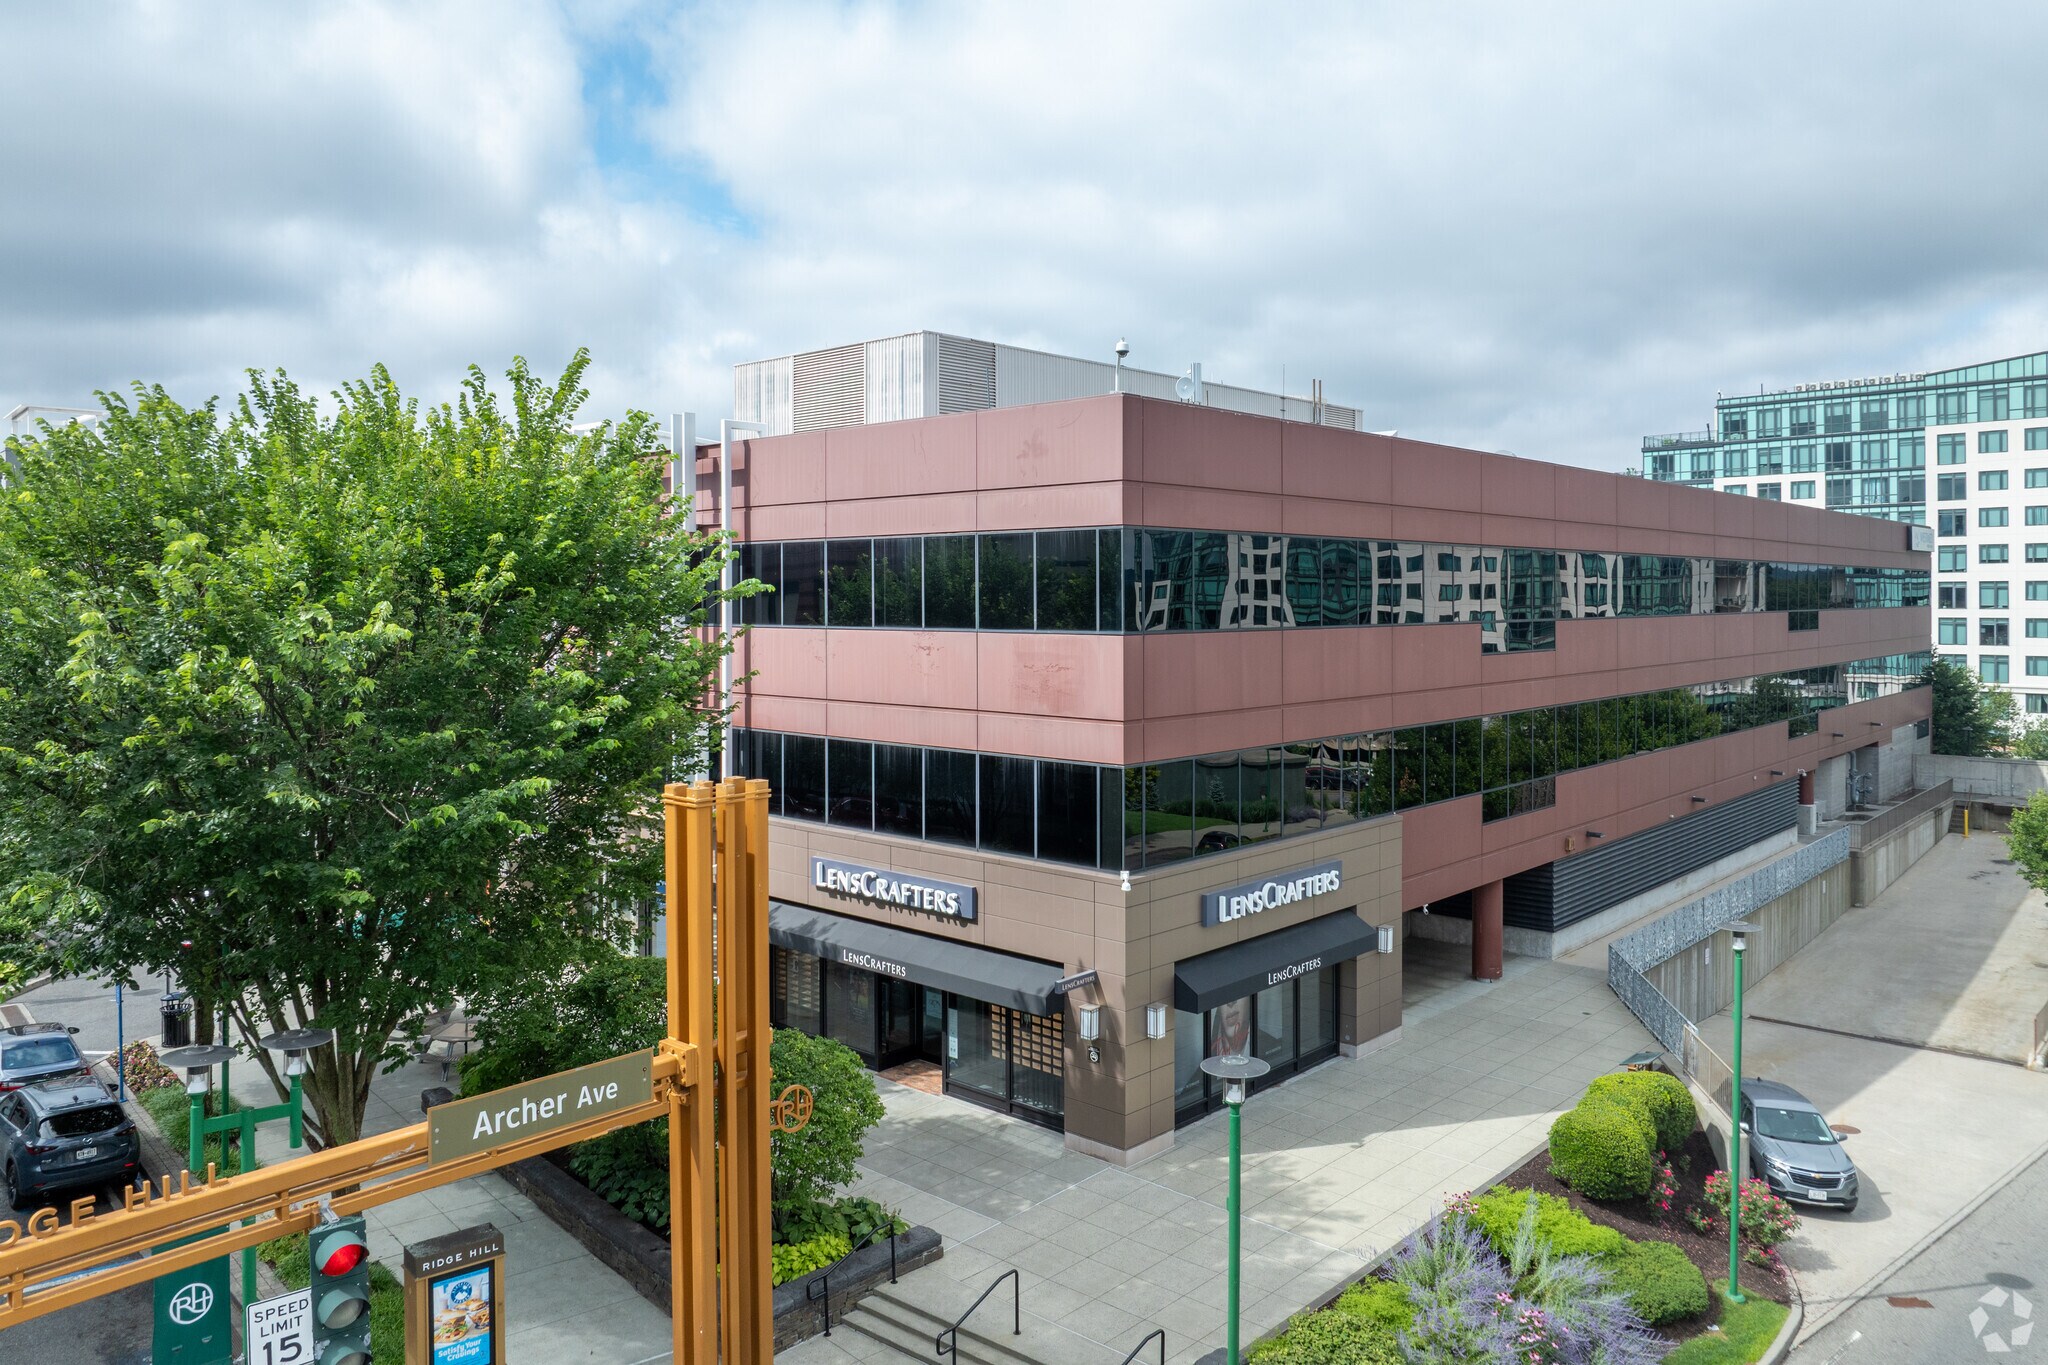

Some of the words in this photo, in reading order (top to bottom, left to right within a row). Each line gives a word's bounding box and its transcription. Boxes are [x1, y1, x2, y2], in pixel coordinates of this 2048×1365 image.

[472, 1092, 568, 1140] Archer
[577, 1082, 618, 1109] Ave
[125, 1162, 229, 1212] HILL
[422, 1252, 463, 1272] RIDGE
[469, 1243, 499, 1258] HILL
[254, 1298, 309, 1323] SPEED
[260, 1315, 303, 1338] LIMIT
[262, 1333, 303, 1365] 15
[438, 1344, 465, 1358] Satisfy
[465, 1338, 482, 1349] Your
[447, 1346, 480, 1361] Cravings
